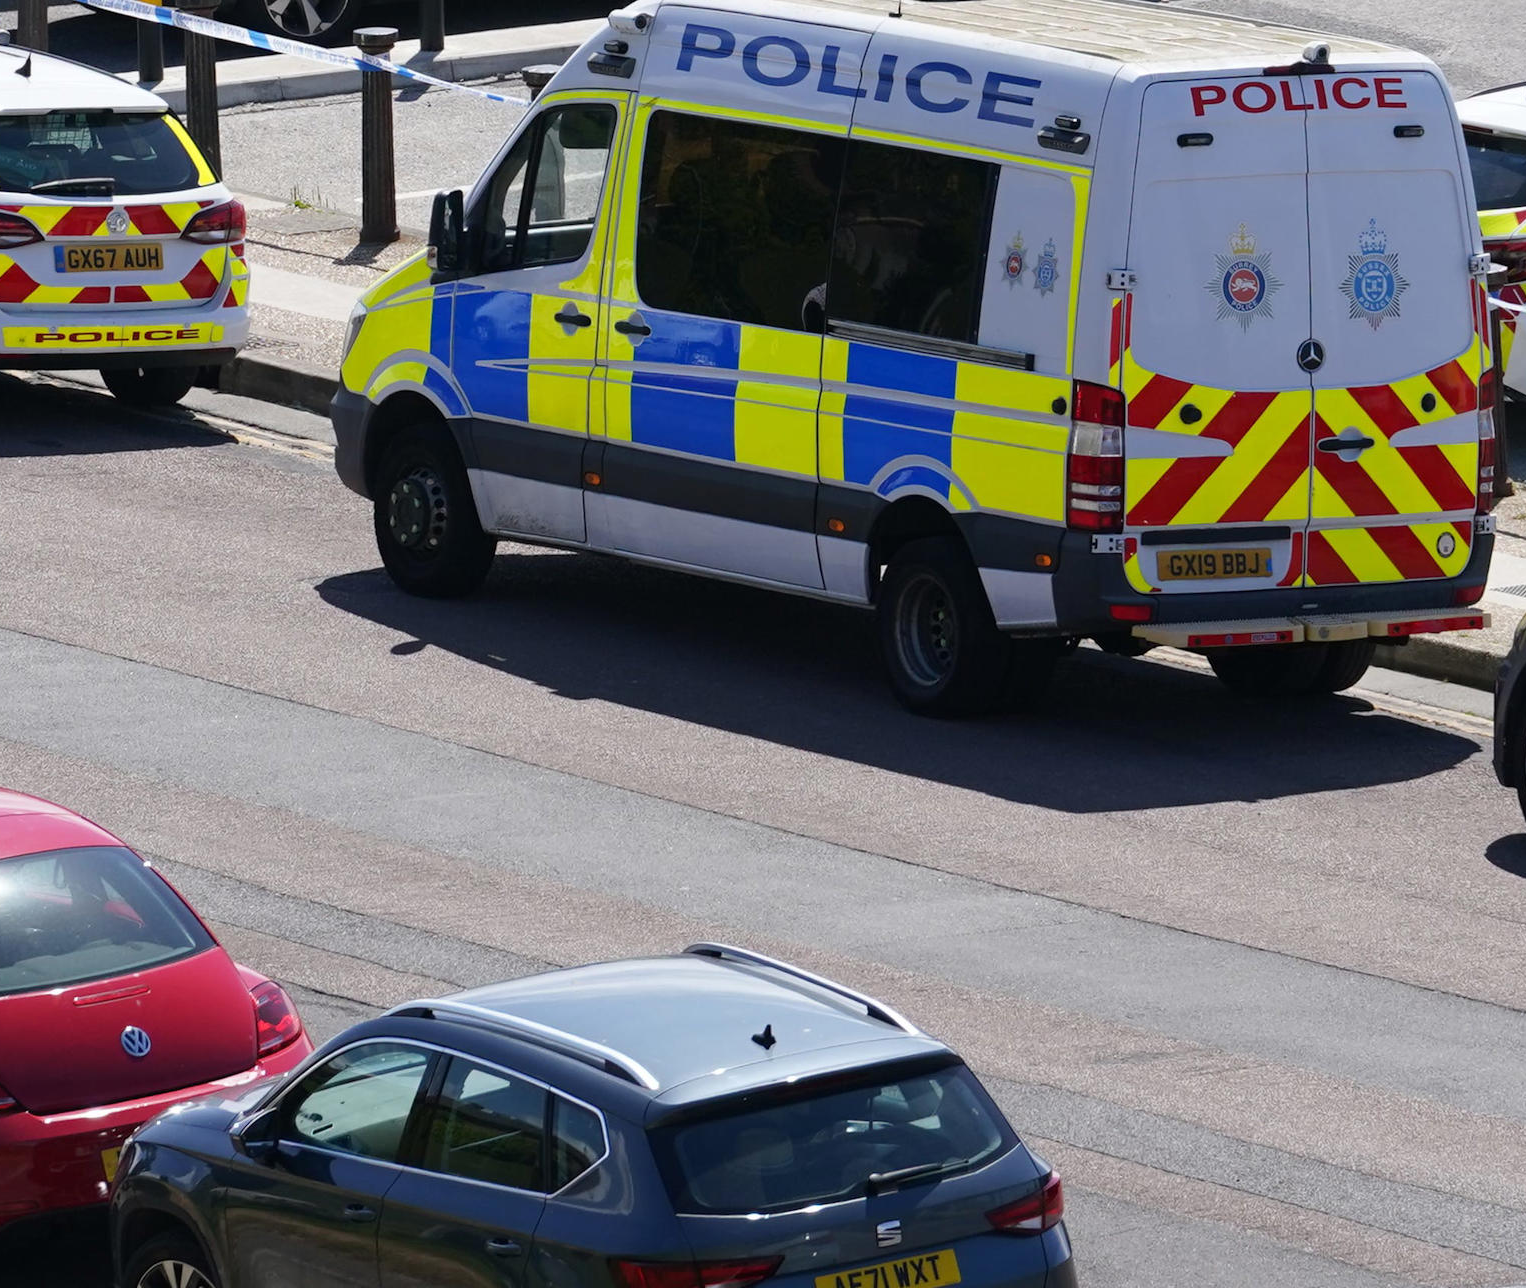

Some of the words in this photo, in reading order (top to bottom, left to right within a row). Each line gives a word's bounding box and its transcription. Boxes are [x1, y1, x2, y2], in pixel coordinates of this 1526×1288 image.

[676, 23, 1042, 128] POLICE
[1190, 77, 1408, 116] POLICE
[67, 248, 117, 269] GX67
[123, 247, 160, 268] AUH
[1231, 300, 1259, 312] POLICE
[1357, 295, 1391, 312] POLICE
[34, 328, 200, 343] POLICE
[1169, 553, 1217, 576] GX19
[1222, 552, 1260, 575] BBJ
[893, 1255, 940, 1288] WXT
